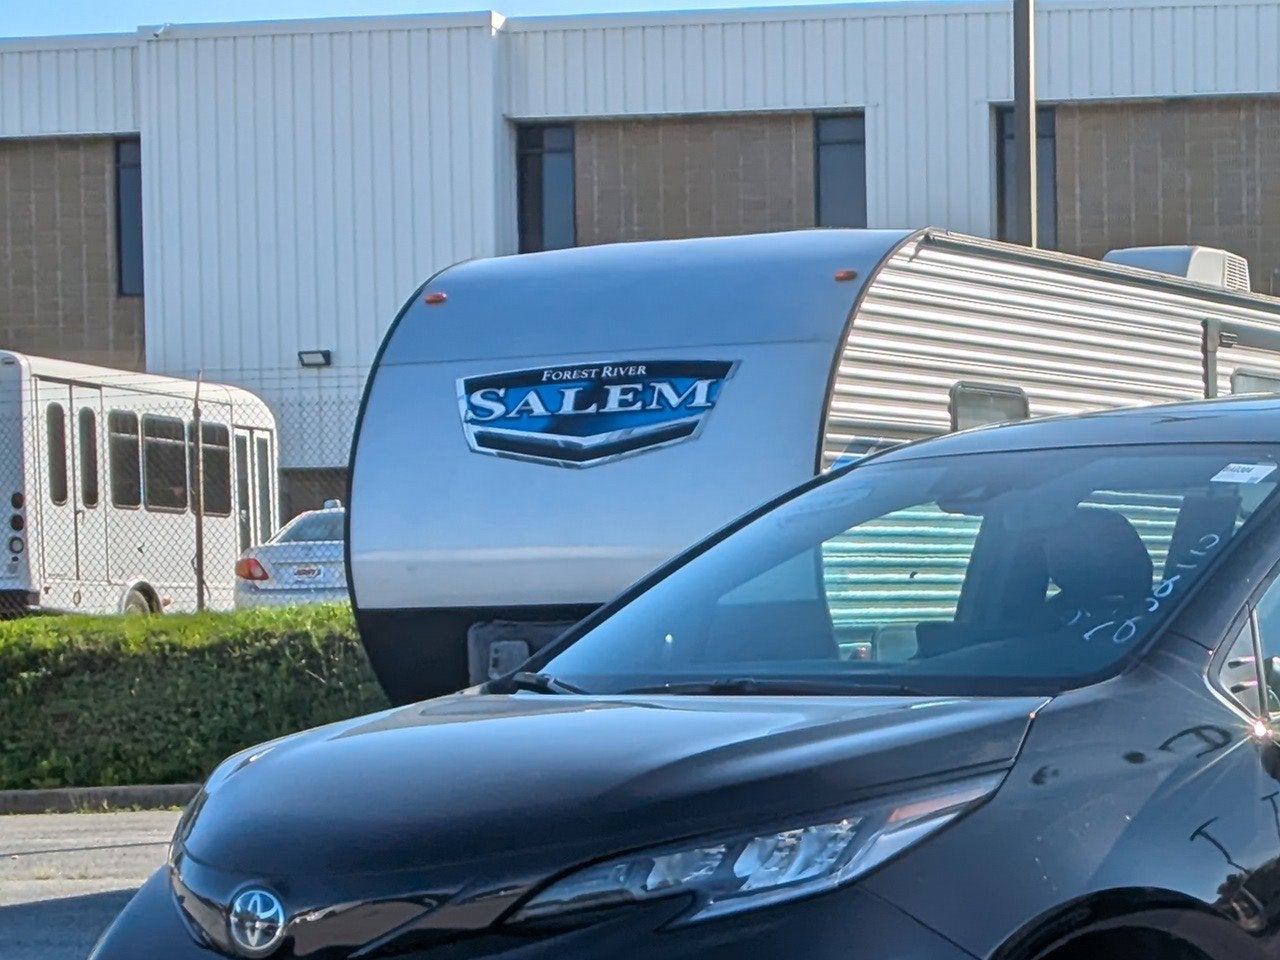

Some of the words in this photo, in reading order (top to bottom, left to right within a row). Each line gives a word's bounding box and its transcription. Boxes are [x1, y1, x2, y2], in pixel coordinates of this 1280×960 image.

[541, 368, 599, 382] FOREST
[602, 365, 647, 379] RIVER
[465, 379, 717, 422] SALEM
